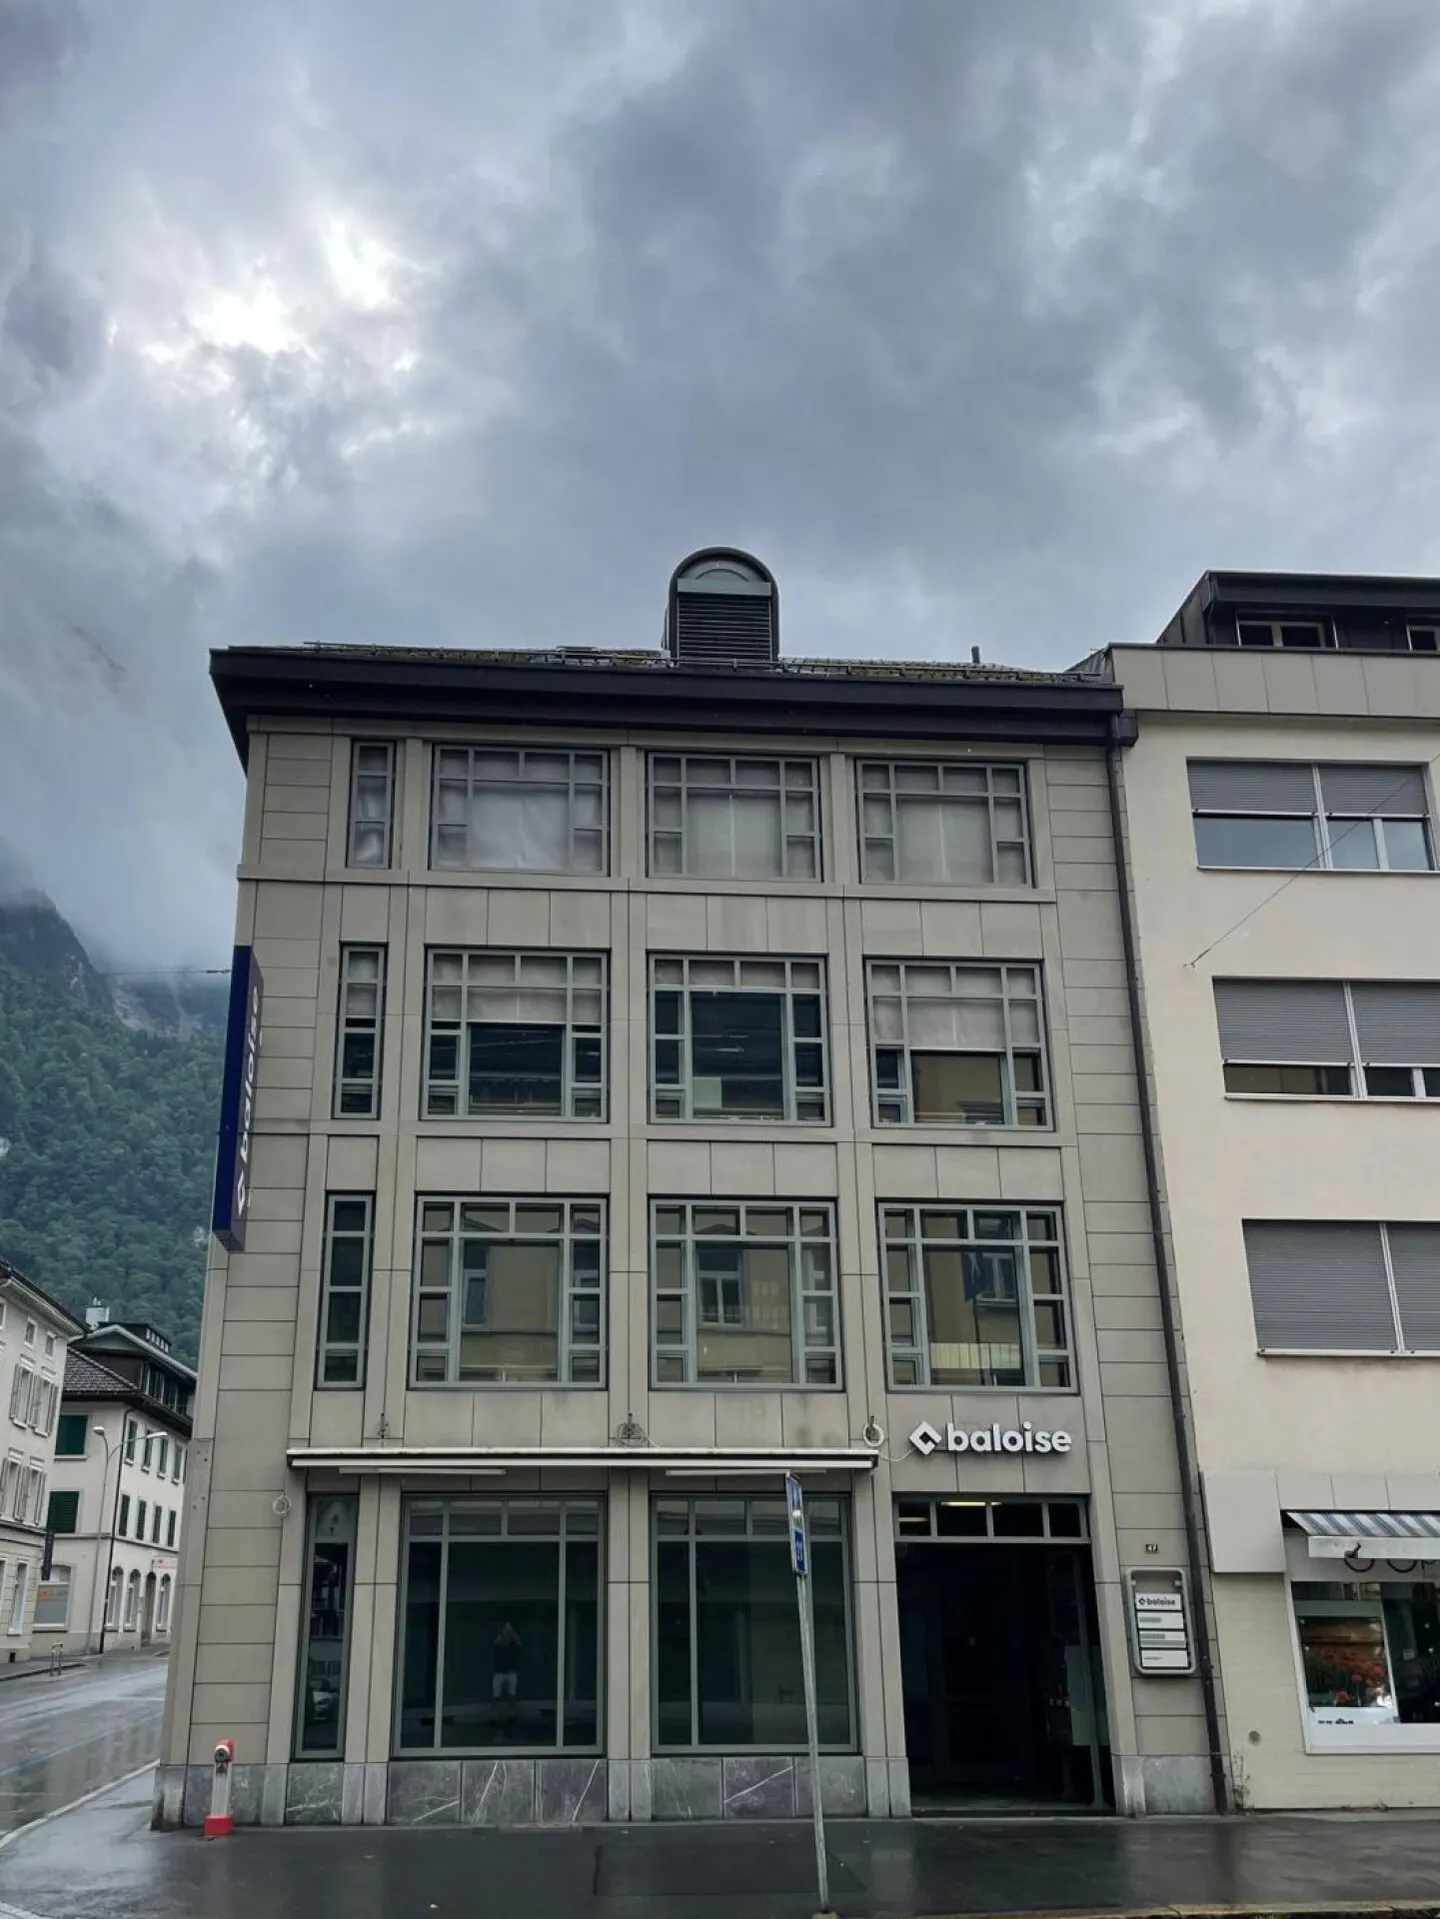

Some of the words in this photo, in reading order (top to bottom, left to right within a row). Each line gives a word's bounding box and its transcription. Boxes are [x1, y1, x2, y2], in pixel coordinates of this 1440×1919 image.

[240, 986, 258, 1163] baloise
[947, 1421, 1072, 1452] baloise
[1147, 1597, 1176, 1605] baloise
